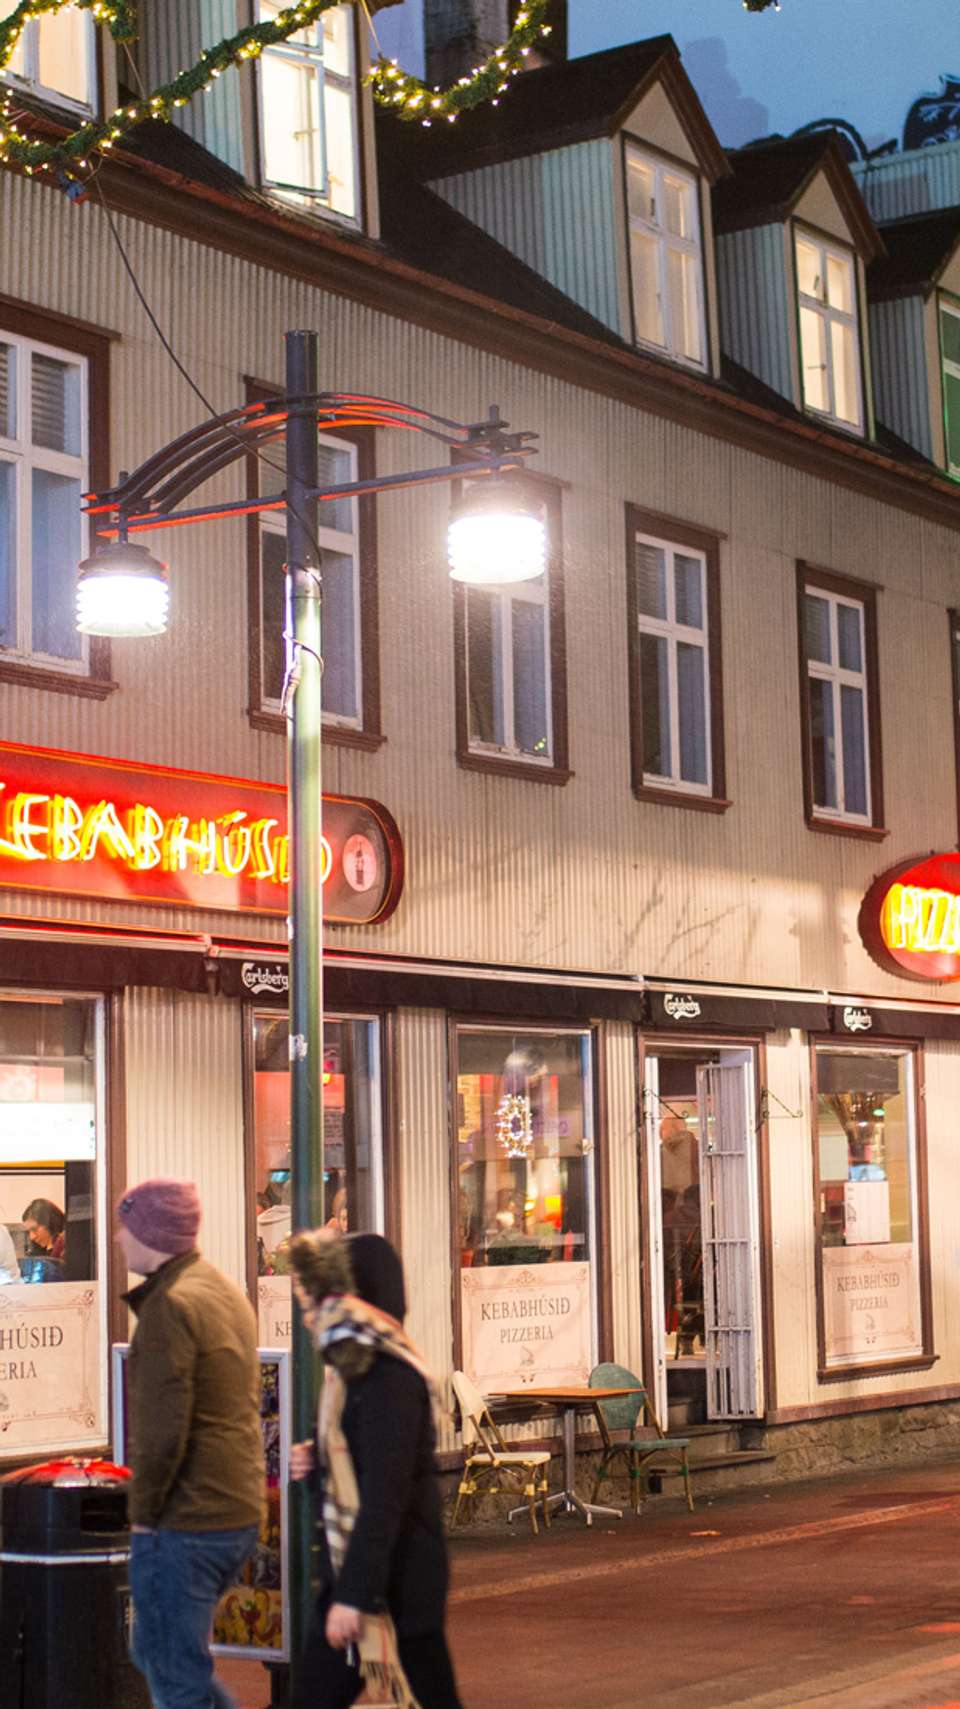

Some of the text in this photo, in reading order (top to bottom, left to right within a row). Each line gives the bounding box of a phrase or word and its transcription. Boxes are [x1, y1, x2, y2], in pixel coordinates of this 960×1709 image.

[241, 962, 289, 994] Carlsberg
[481, 1294, 571, 1321] KEBABHÚSIÐ
[500, 1325, 554, 1343] PIZZERIA
